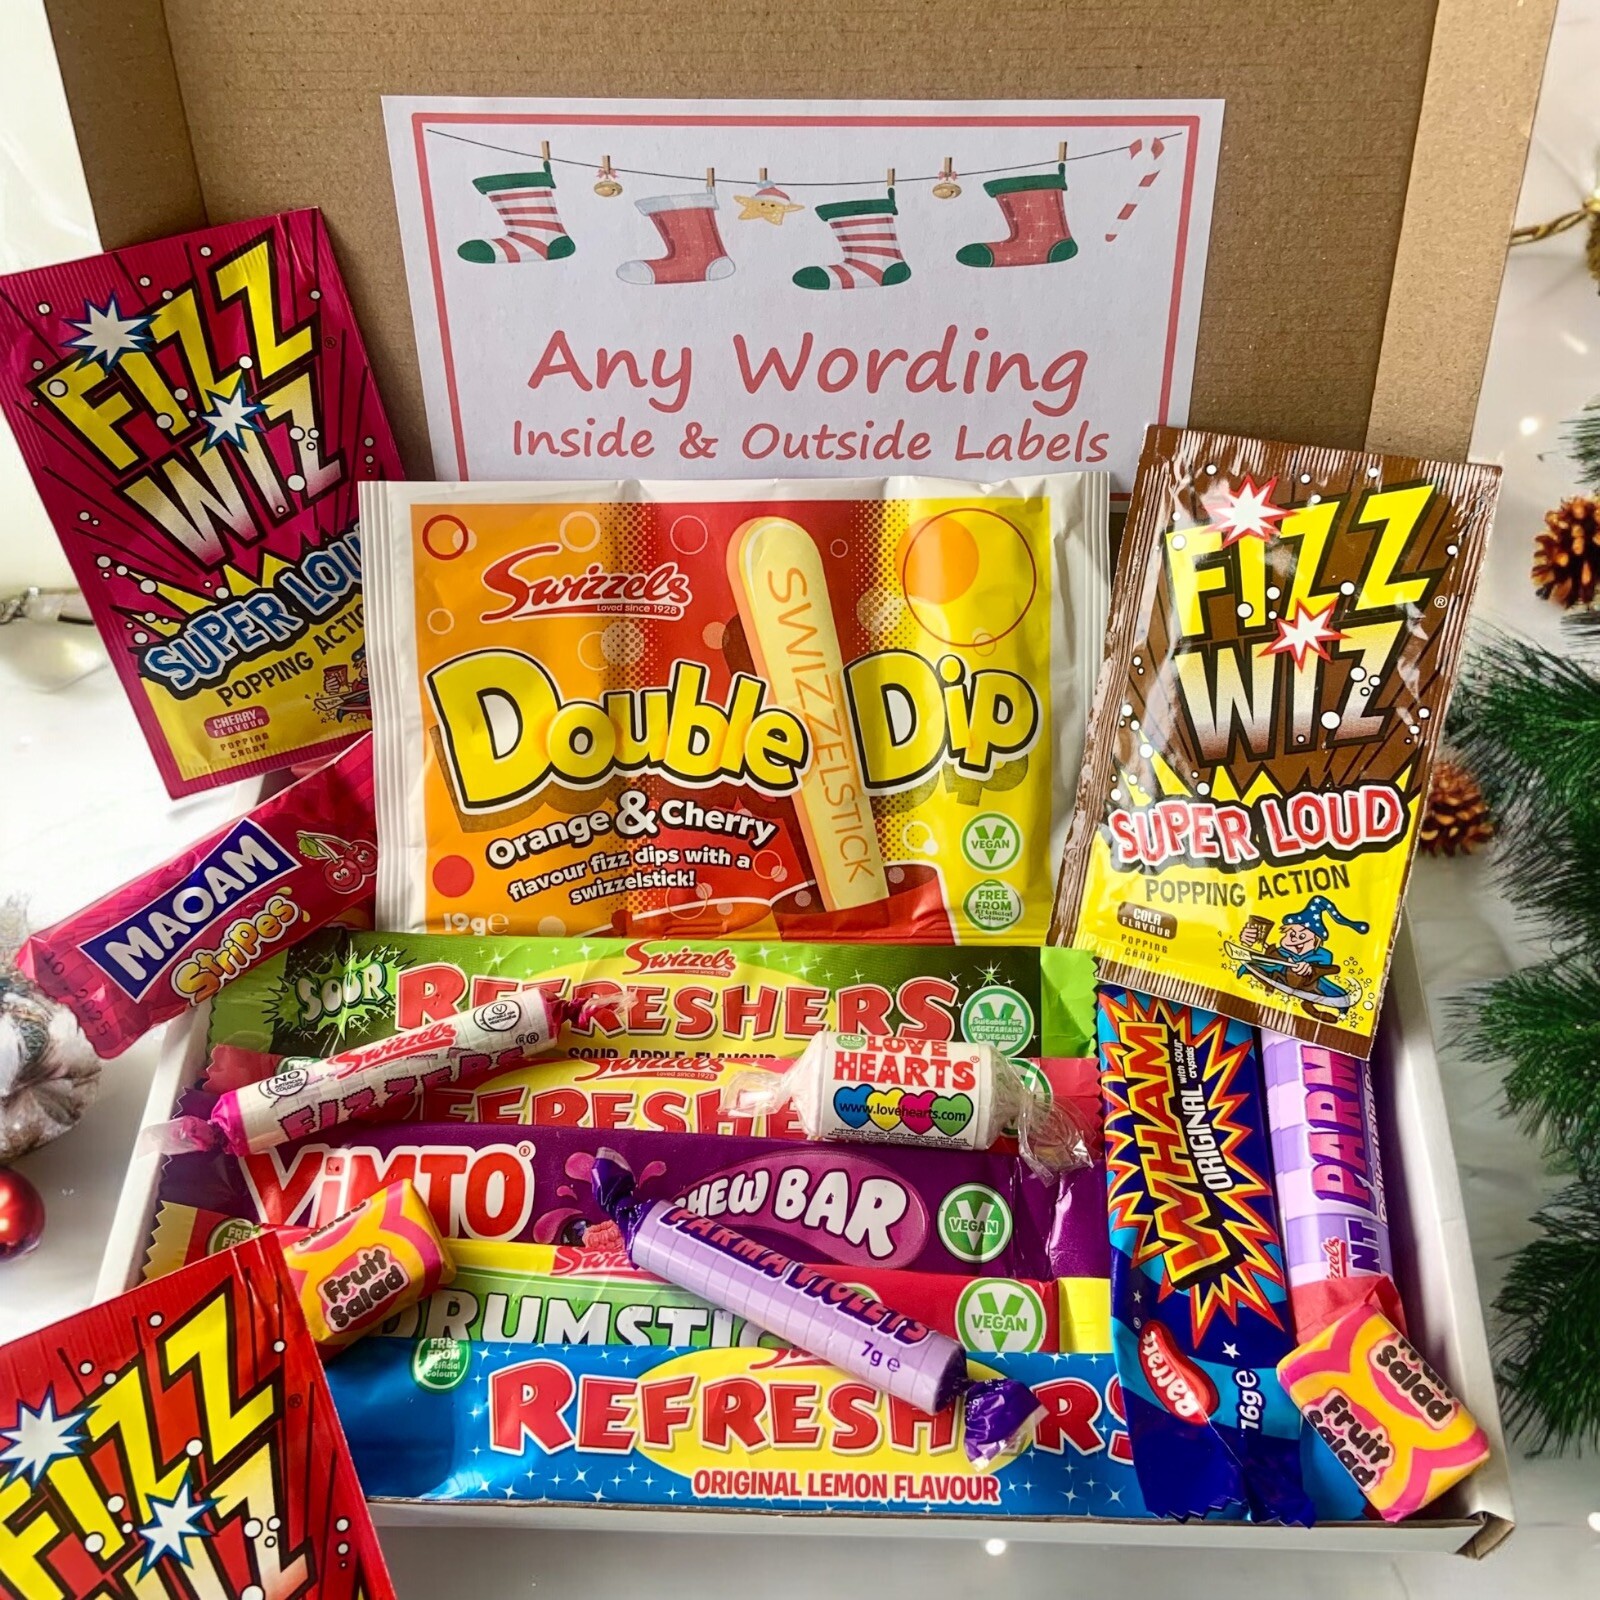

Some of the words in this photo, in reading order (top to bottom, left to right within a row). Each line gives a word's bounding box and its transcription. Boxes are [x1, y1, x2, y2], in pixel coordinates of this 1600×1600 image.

[34, 237, 316, 473] FIZZ
[528, 330, 692, 413] Any
[733, 324, 1088, 418] Wording
[513, 418, 655, 458] Inside
[680, 421, 718, 459] &
[742, 419, 933, 461] Outside
[954, 420, 1110, 463] Labels
[121, 369, 344, 569] WIZ
[1164, 482, 1440, 638] FIZZ
[481, 544, 691, 621] Swizzels
[145, 592, 303, 690] SUPER
[280, 524, 363, 616] LOU
[597, 603, 624, 613] Loved
[625, 603, 650, 613] since
[652, 604, 677, 615] 1928
[216, 651, 314, 707] POPPING
[312, 603, 364, 655] ACTIO
[1173, 619, 1403, 762] WIZ
[213, 709, 257, 729] CHERRY
[213, 718, 265, 737] FLAVOUR
[427, 649, 809, 811] Double
[843, 651, 1040, 788] Dip
[767, 566, 875, 884] SWIZZELSTICK
[220, 732, 270, 751] POPPING
[488, 811, 611, 867] Orange
[615, 791, 659, 836] &
[661, 801, 777, 848] Cherry
[971, 839, 1010, 850] VEGAN
[1108, 801, 1256, 866] SUPER
[1265, 784, 1404, 856] LOUD
[508, 861, 586, 901] flavour
[590, 851, 629, 872] fizz
[634, 845, 680, 868] dips
[684, 846, 731, 867] with
[736, 855, 751, 869] a
[570, 870, 695, 905] swizzelstick!
[978, 889, 1008, 900] FREE
[1145, 878, 1246, 907] POPPING
[1257, 864, 1351, 900] ACTION
[105, 834, 279, 981] MAOAM
[974, 901, 1012, 911] FROM
[1121, 916, 1171, 937] FLAVOUR
[1133, 907, 1162, 926] COLA
[171, 895, 301, 1005] Stripes
[622, 938, 737, 975] Swizzels
[1121, 933, 1168, 954] POPPING
[1125, 947, 1160, 963] CANDY
[299, 961, 390, 1022] SOUR
[329, 1022, 457, 1079] Swizzels
[867, 1036, 948, 1057] LOVE
[970, 1025, 1024, 1034] VEGETARIANS
[274, 1070, 300, 1084] NO
[833, 1051, 976, 1091] HEARTS
[1177, 1065, 1188, 1084] with
[1185, 1046, 1198, 1078] crystals
[839, 1100, 967, 1123] www.lovehearts.com
[1301, 1045, 1376, 1214] PARM
[1118, 1022, 1231, 1284] WHAM
[1181, 1084, 1234, 1190] ORIGINAL
[674, 1170, 770, 1217] HEW
[775, 1168, 907, 1257] BAR
[950, 1217, 999, 1235] VEGAN
[658, 1206, 792, 1278] PARMA
[323, 1249, 387, 1304] Fruit
[430, 1337, 459, 1349] FREE
[971, 1314, 1028, 1332] VEGAN
[425, 1369, 458, 1378] Colours
[860, 1340, 884, 1367] 7g
[1143, 1330, 1199, 1417] Barratt
[489, 1359, 1133, 1465] REFRESHR
[1323, 1395, 1391, 1465] Fruit
[694, 1469, 801, 1497] ORIGINAL
[807, 1472, 887, 1500] LEMON
[895, 1475, 1000, 1502] FLAVOUR
